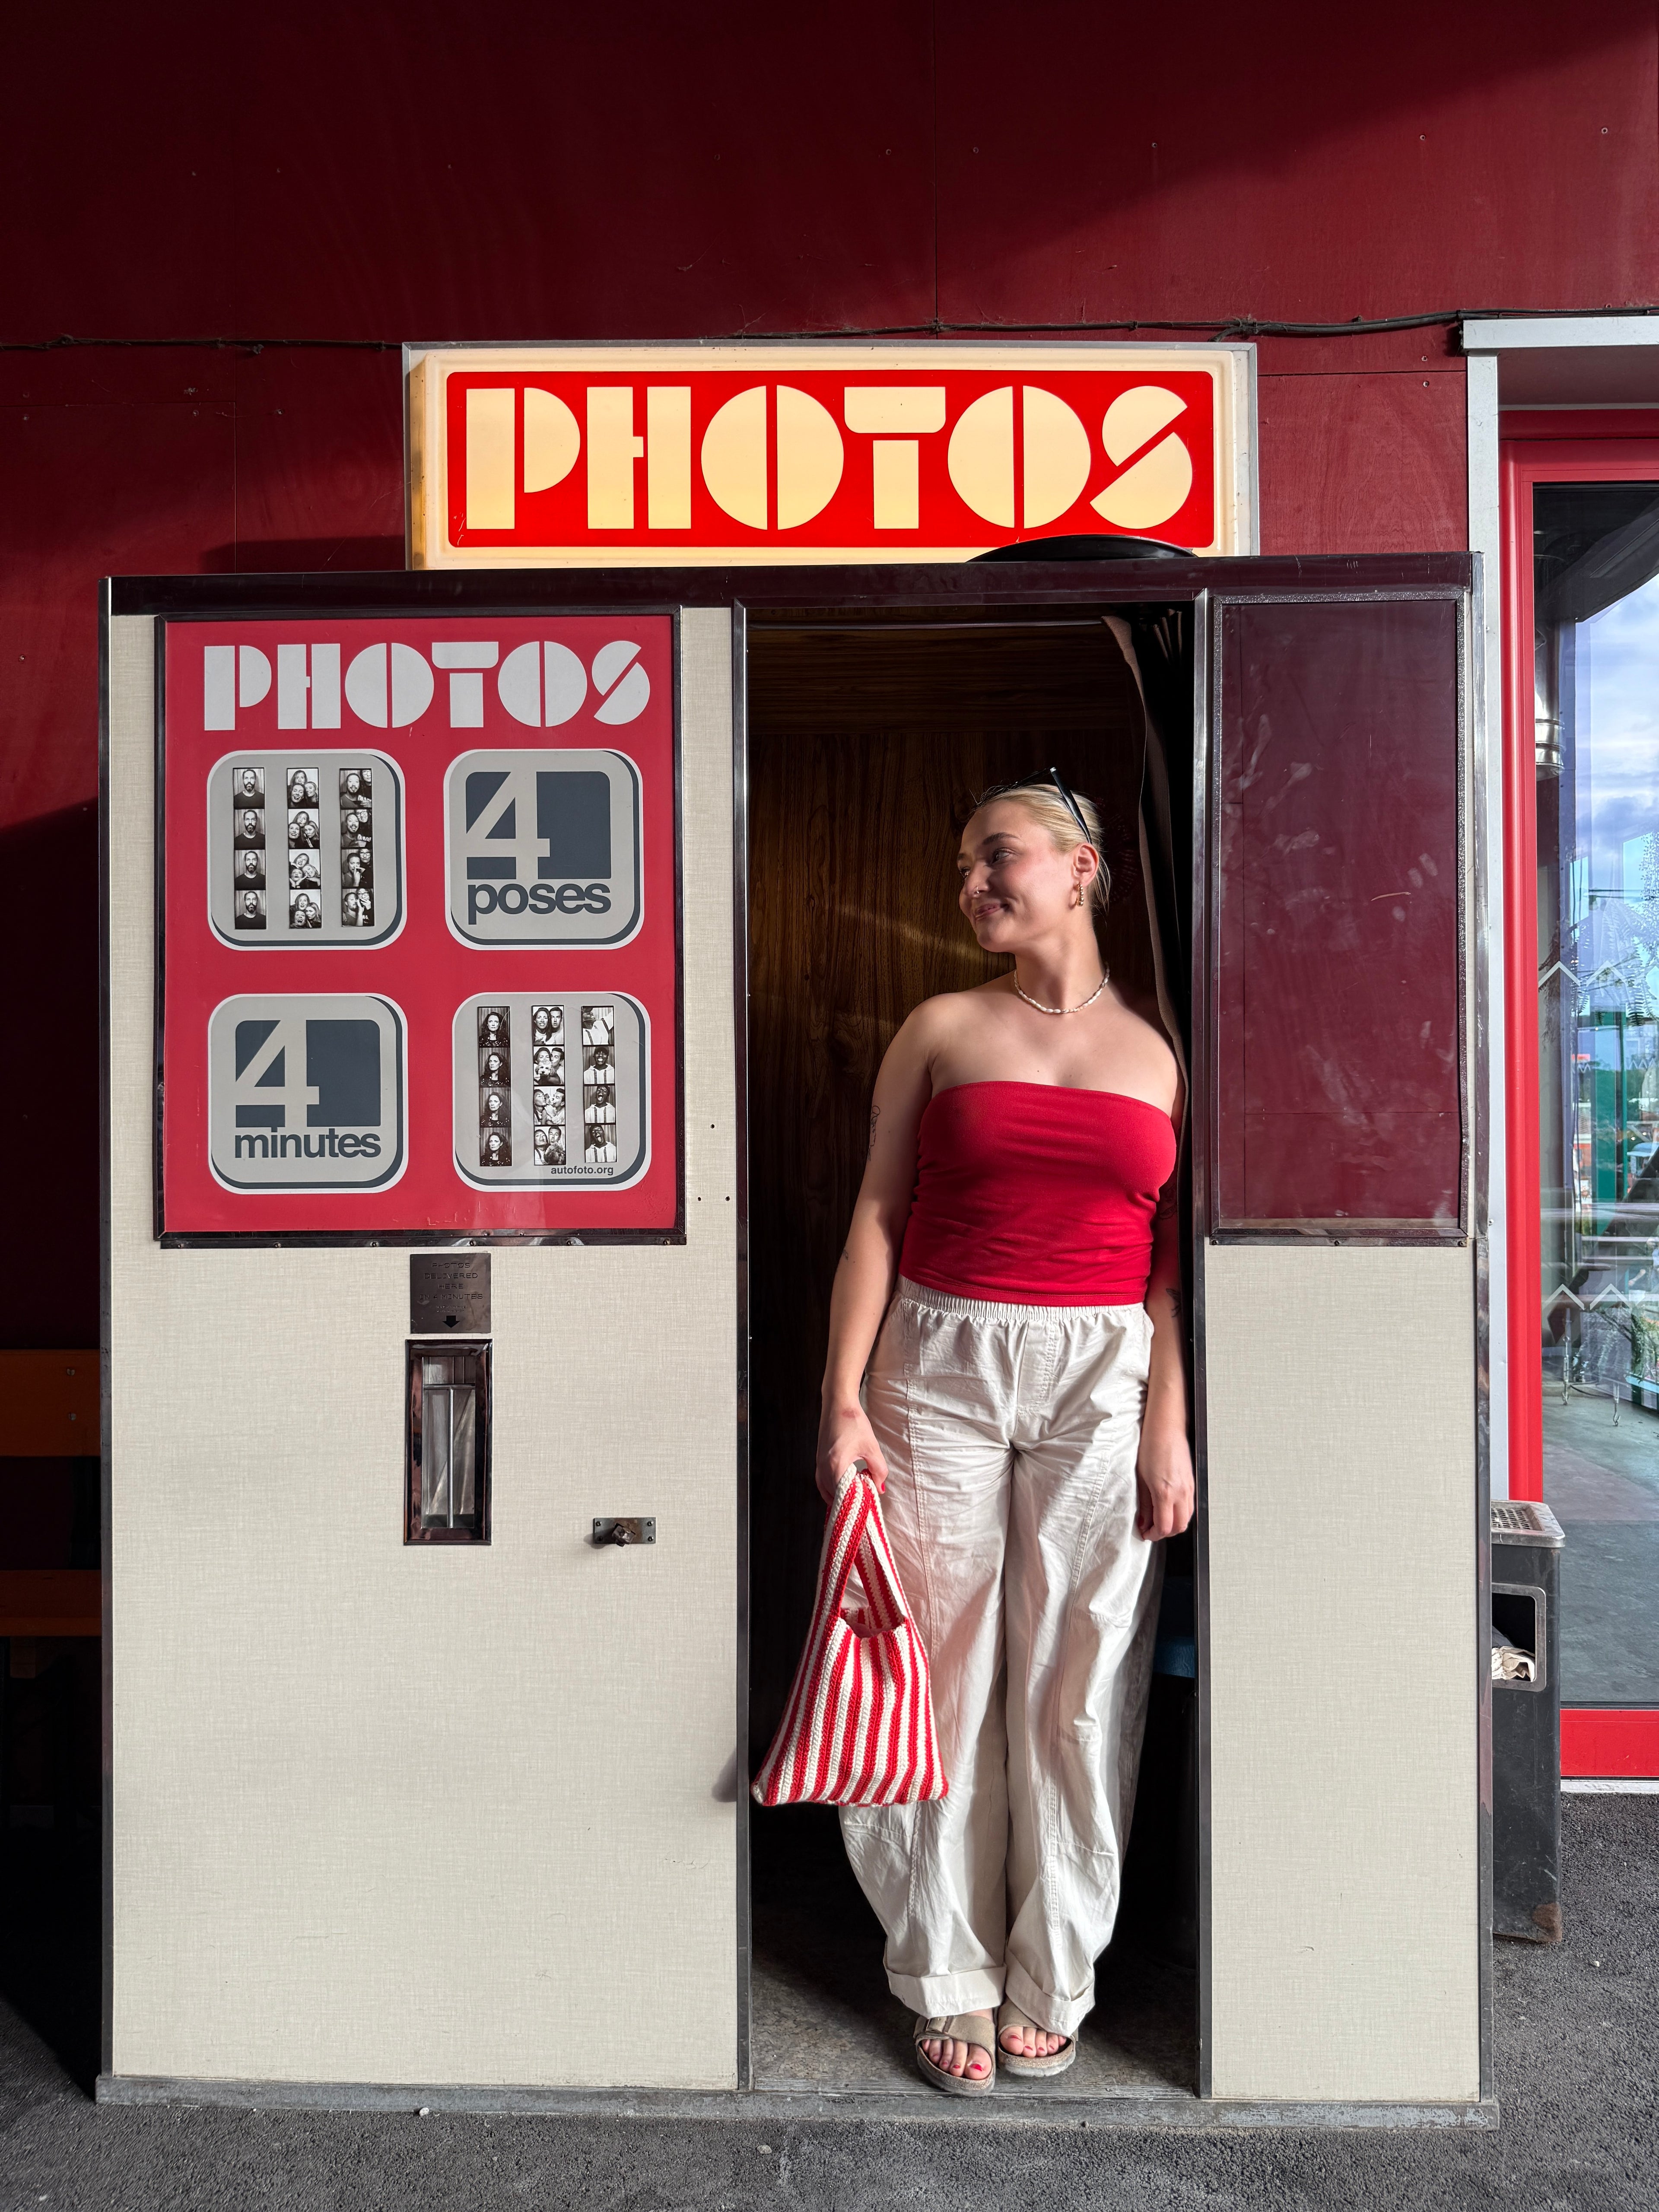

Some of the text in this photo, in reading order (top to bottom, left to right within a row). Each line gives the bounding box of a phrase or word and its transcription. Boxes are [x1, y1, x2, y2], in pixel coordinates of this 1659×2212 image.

[465, 385, 1193, 530] PHOTOS
[204, 640, 650, 731] PHOTOS
[466, 771, 550, 879] 4
[468, 883, 611, 925] poses
[235, 1020, 320, 1127] 4
[235, 1126, 381, 1158] minutes
[551, 1166, 613, 1176] autofoto.org
